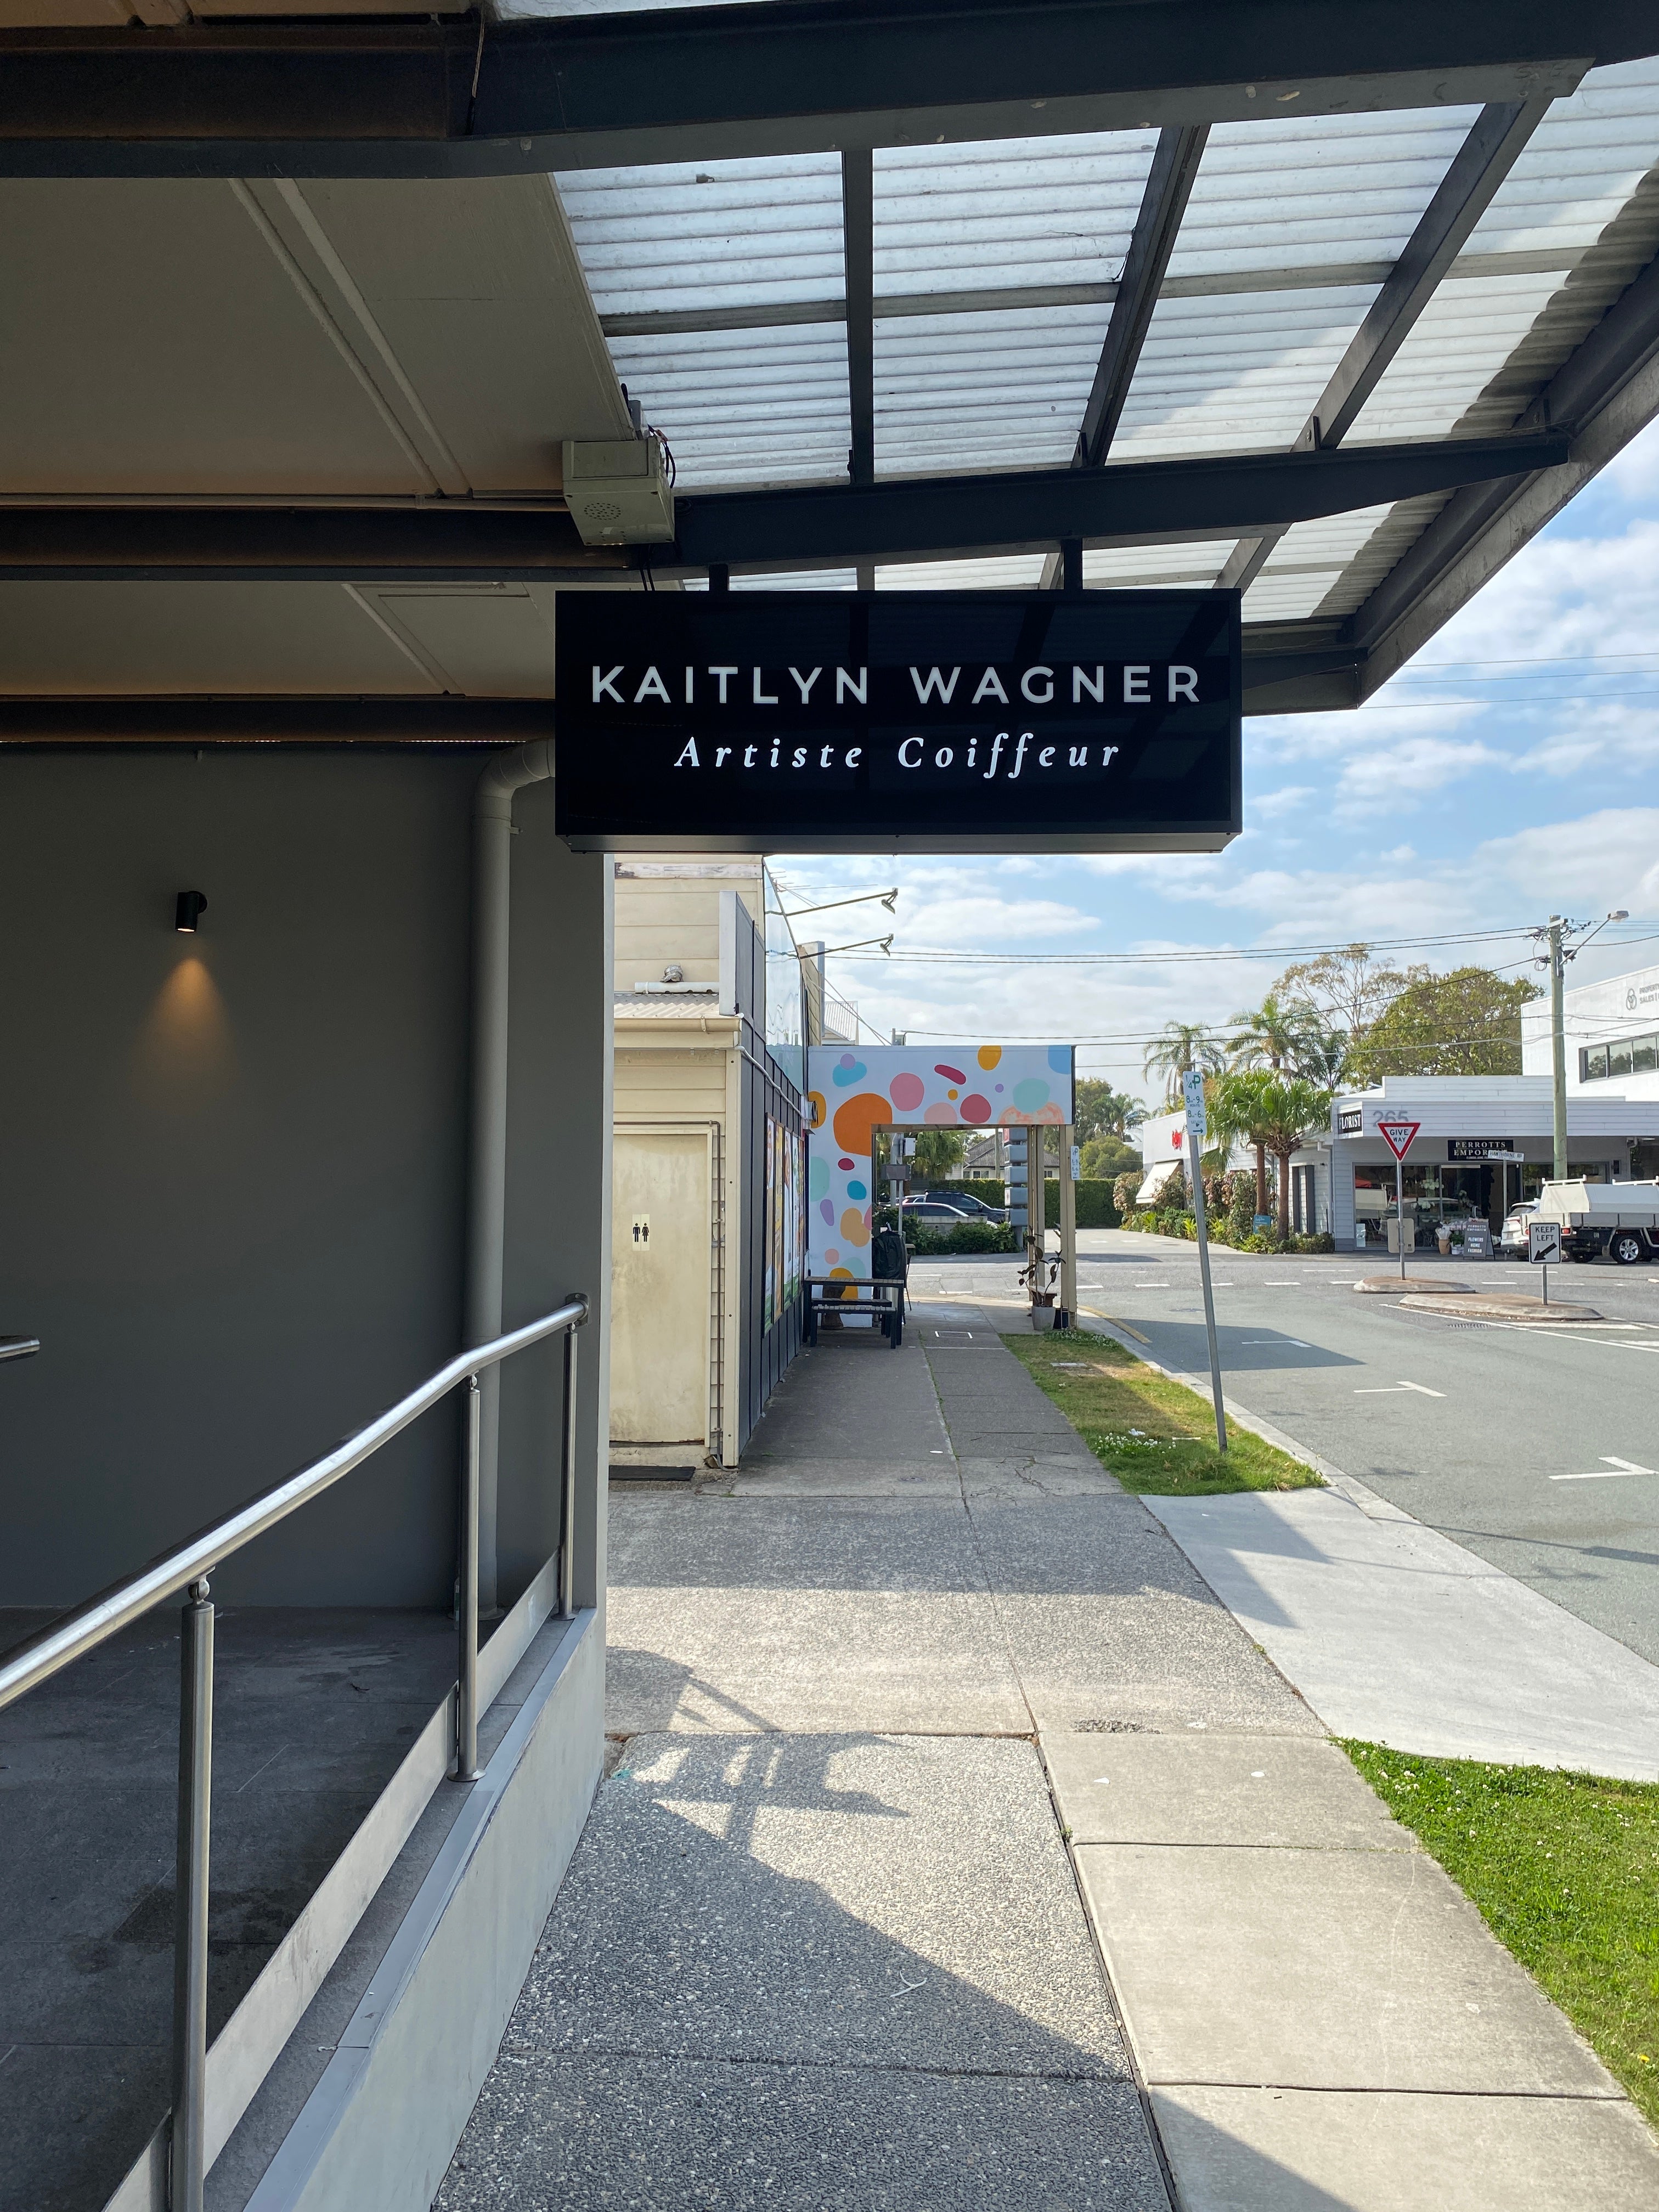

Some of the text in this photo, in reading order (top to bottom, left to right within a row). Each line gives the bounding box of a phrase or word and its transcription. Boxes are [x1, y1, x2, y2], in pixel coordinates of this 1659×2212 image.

[592, 665, 1200, 704] KAITLYN WAGNER
[674, 732, 1119, 779] Artiste Coiffeur
[1339, 1114, 1361, 1130] FLORIST
[1373, 1110, 1409, 1127] 265
